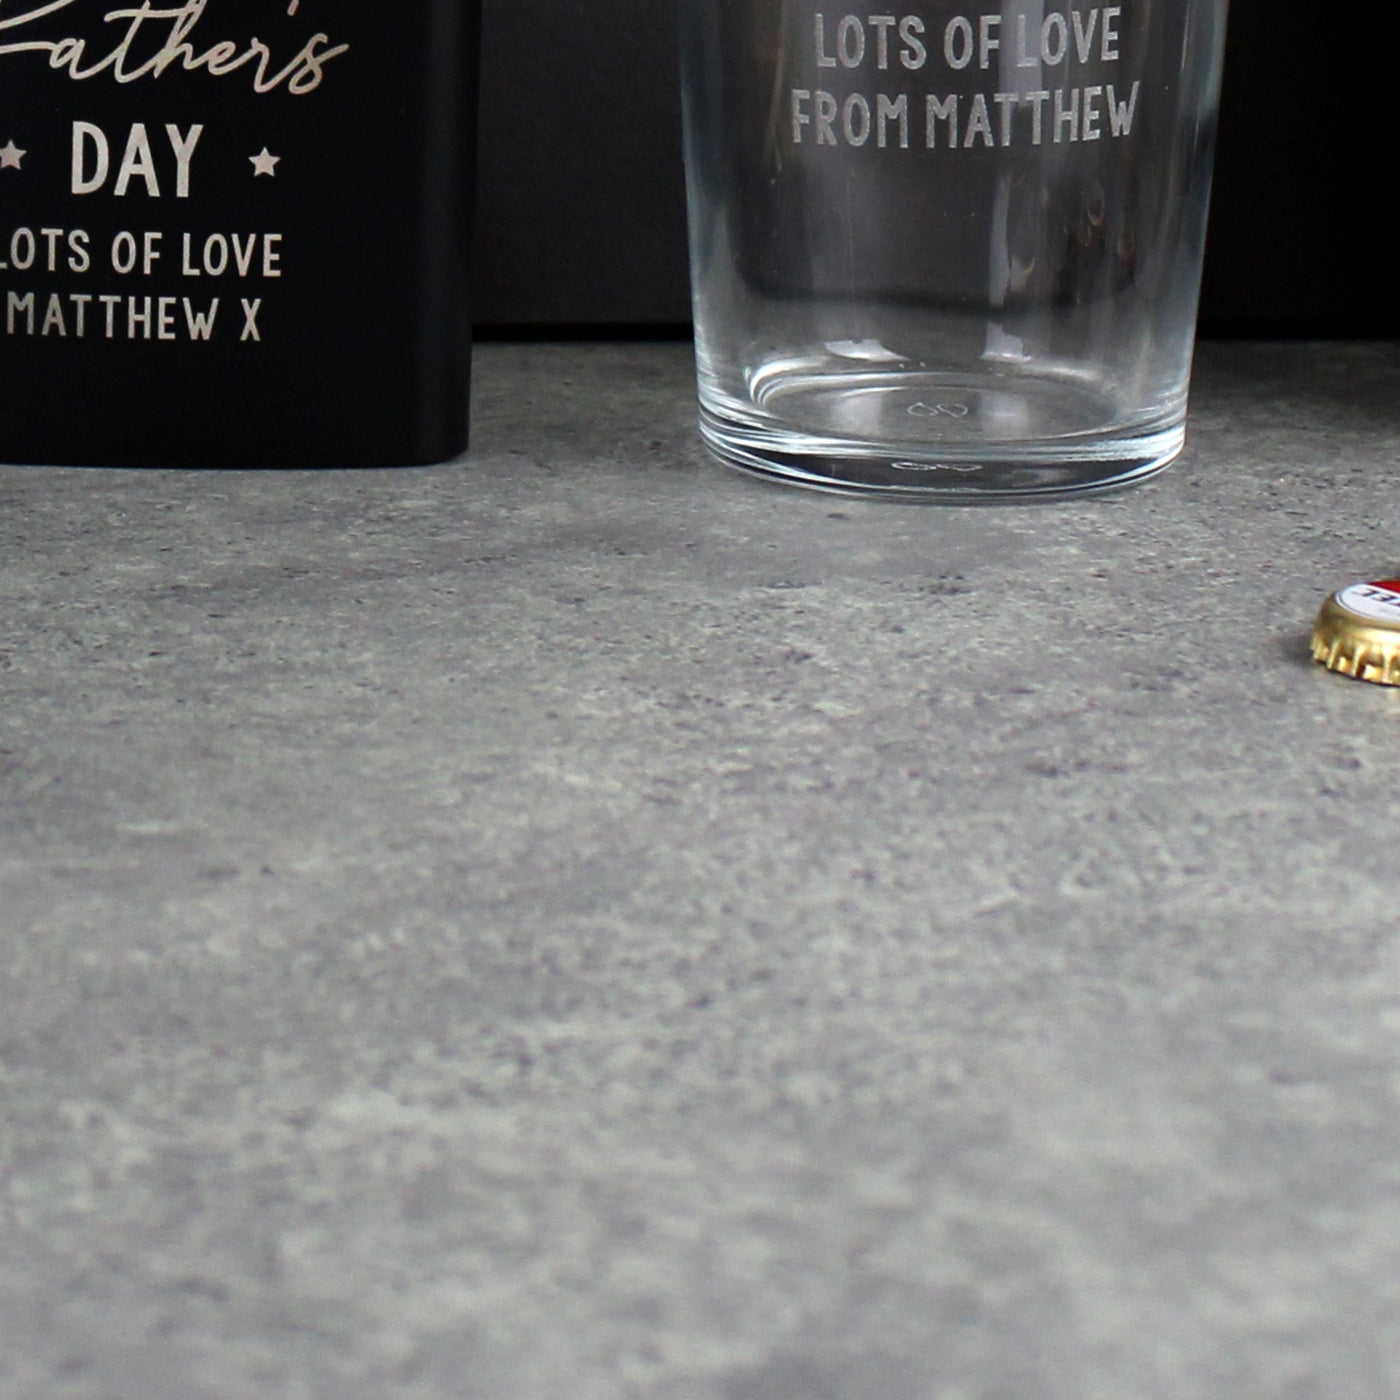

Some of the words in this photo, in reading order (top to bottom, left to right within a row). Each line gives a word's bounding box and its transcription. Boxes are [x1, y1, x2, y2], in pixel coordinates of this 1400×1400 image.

[814, 13, 926, 70] LOTS
[944, 15, 1001, 70] OF
[1016, 7, 1121, 68] LOVE
[792, 88, 908, 148] FROM
[925, 81, 1139, 148] MATTHEW
[71, 121, 204, 198] DAY
[111, 231, 162, 275] OF
[182, 233, 282, 277] LOVE
[7, 291, 220, 341] MATTHEW
[240, 298, 261, 341] X
